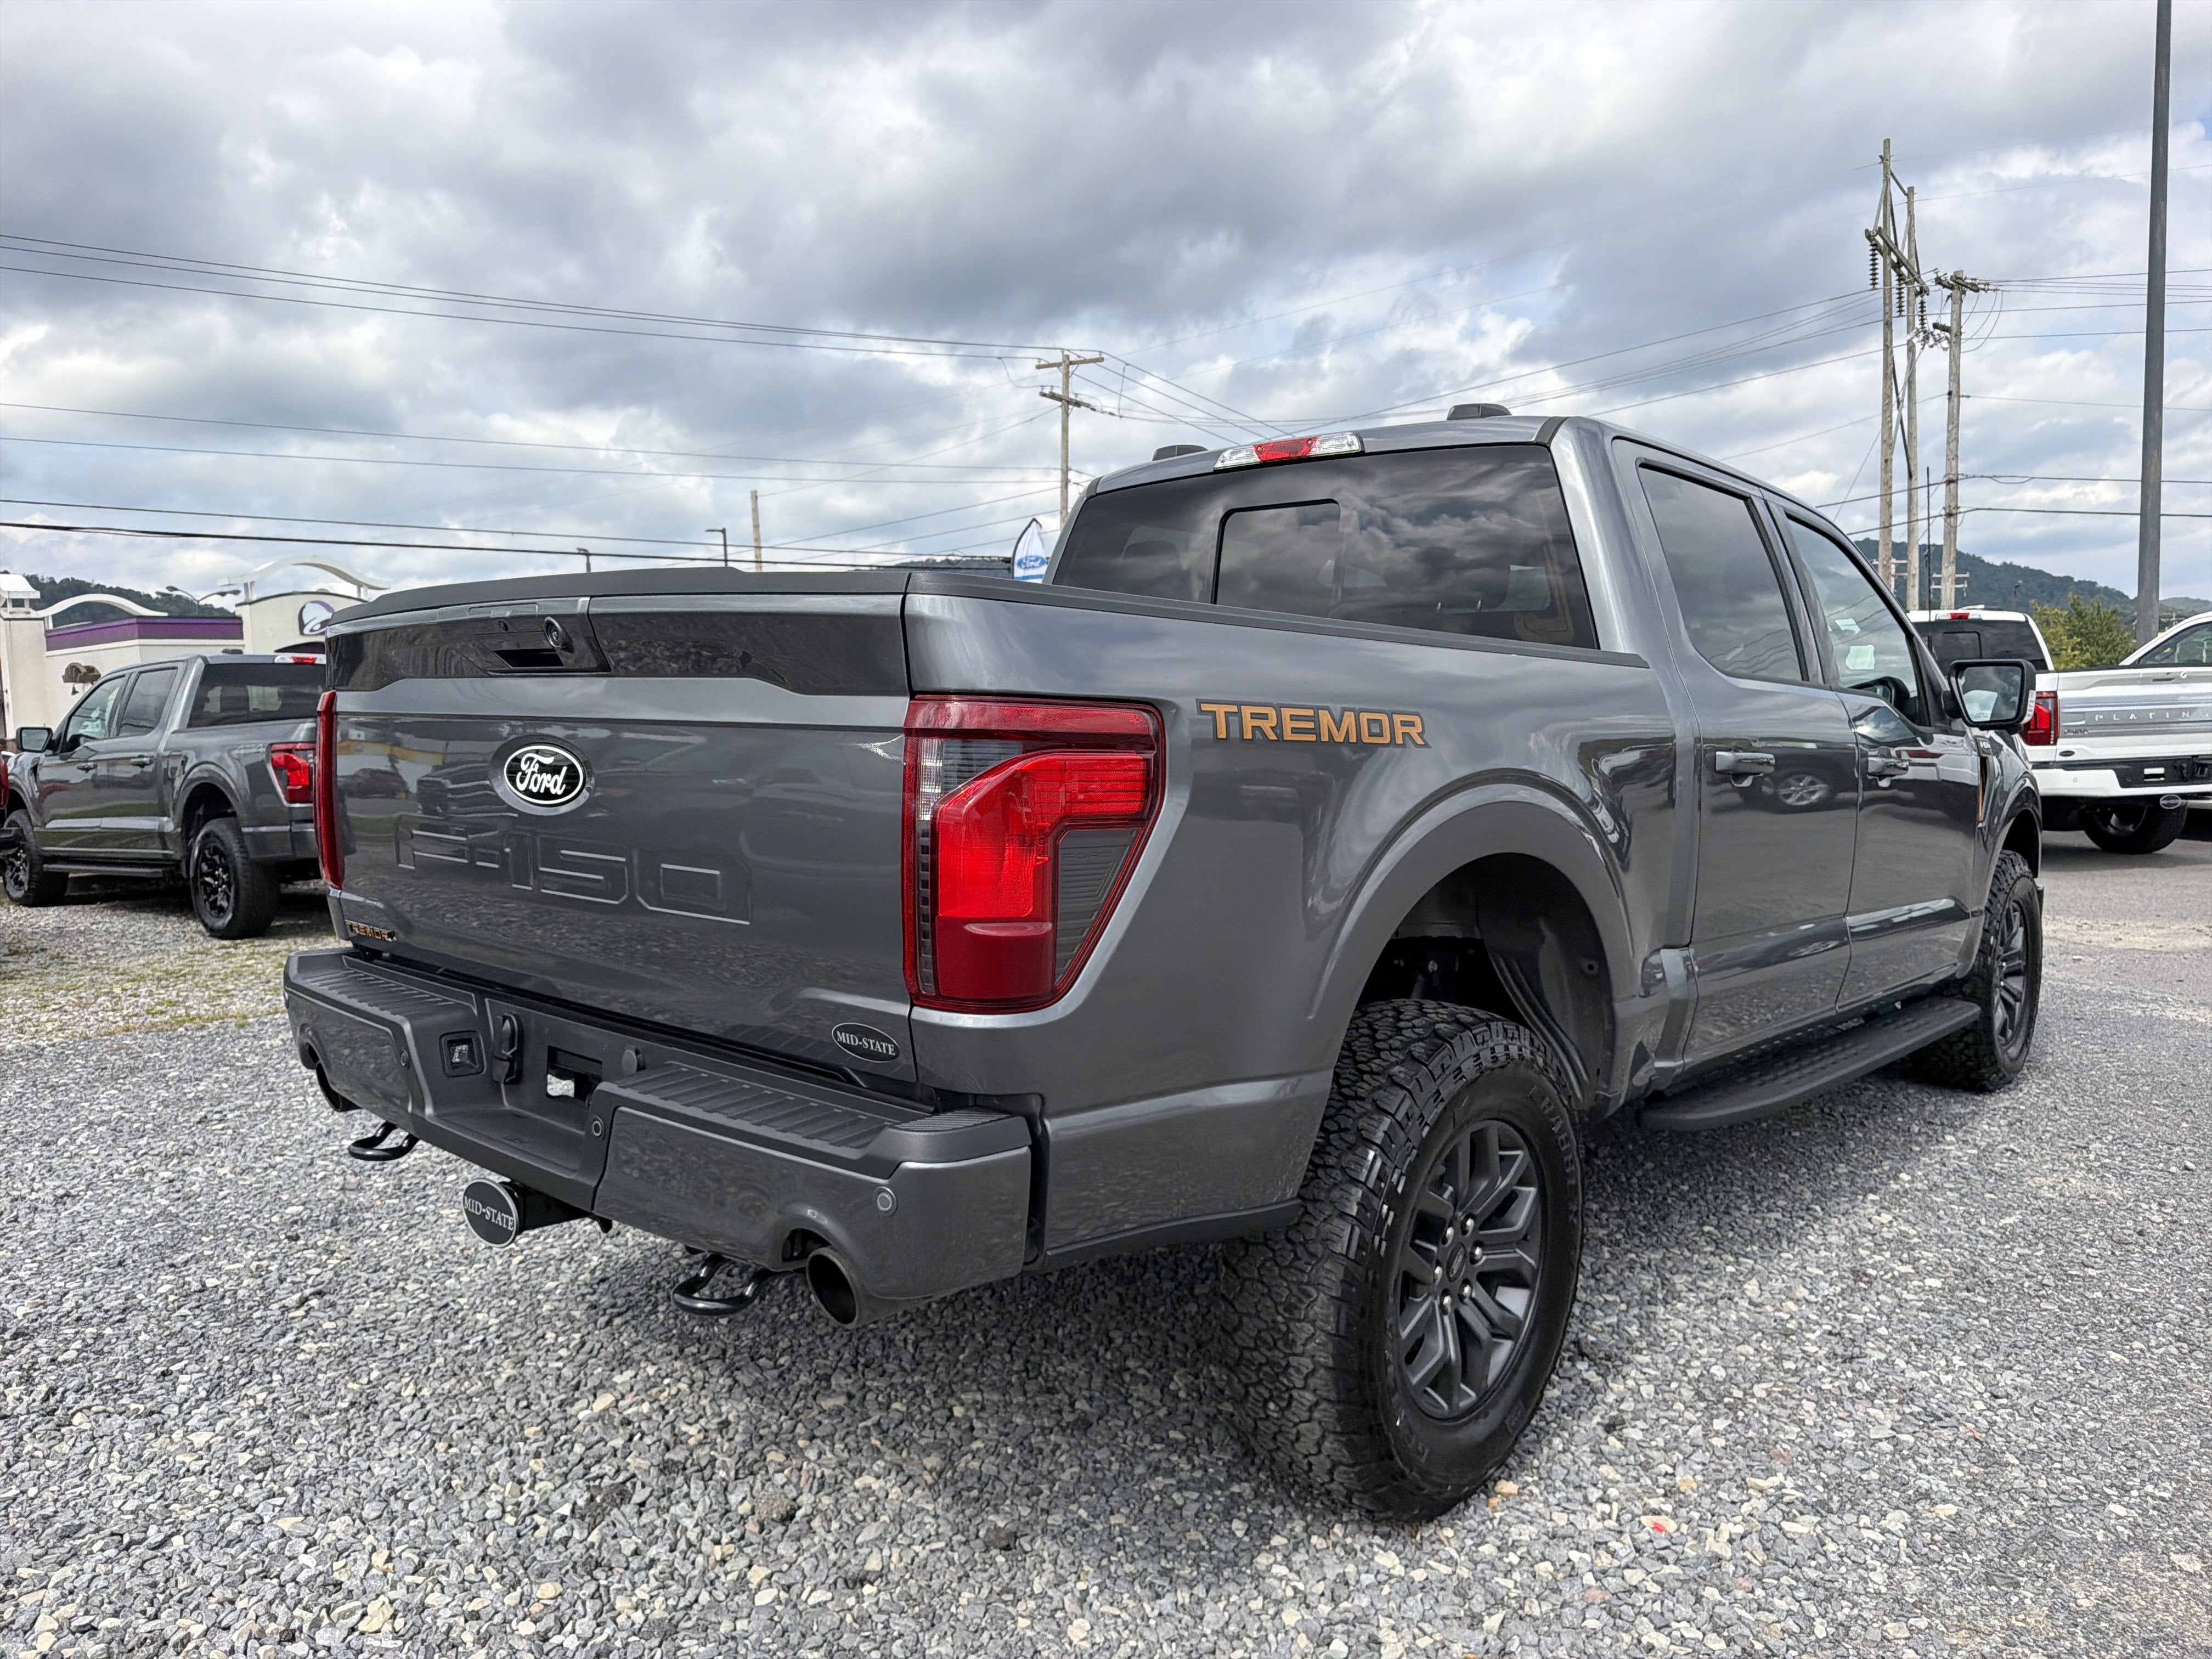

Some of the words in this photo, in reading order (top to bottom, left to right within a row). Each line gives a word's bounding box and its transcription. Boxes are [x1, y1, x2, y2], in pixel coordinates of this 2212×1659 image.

[1020, 557, 1042, 568] Ford
[1198, 701, 1428, 747] TREMOR
[516, 753, 567, 795] Ford
[345, 920, 392, 941] TREMOR
[836, 1031, 896, 1056] MID-STATE
[464, 1196, 514, 1231] MID-STATE
